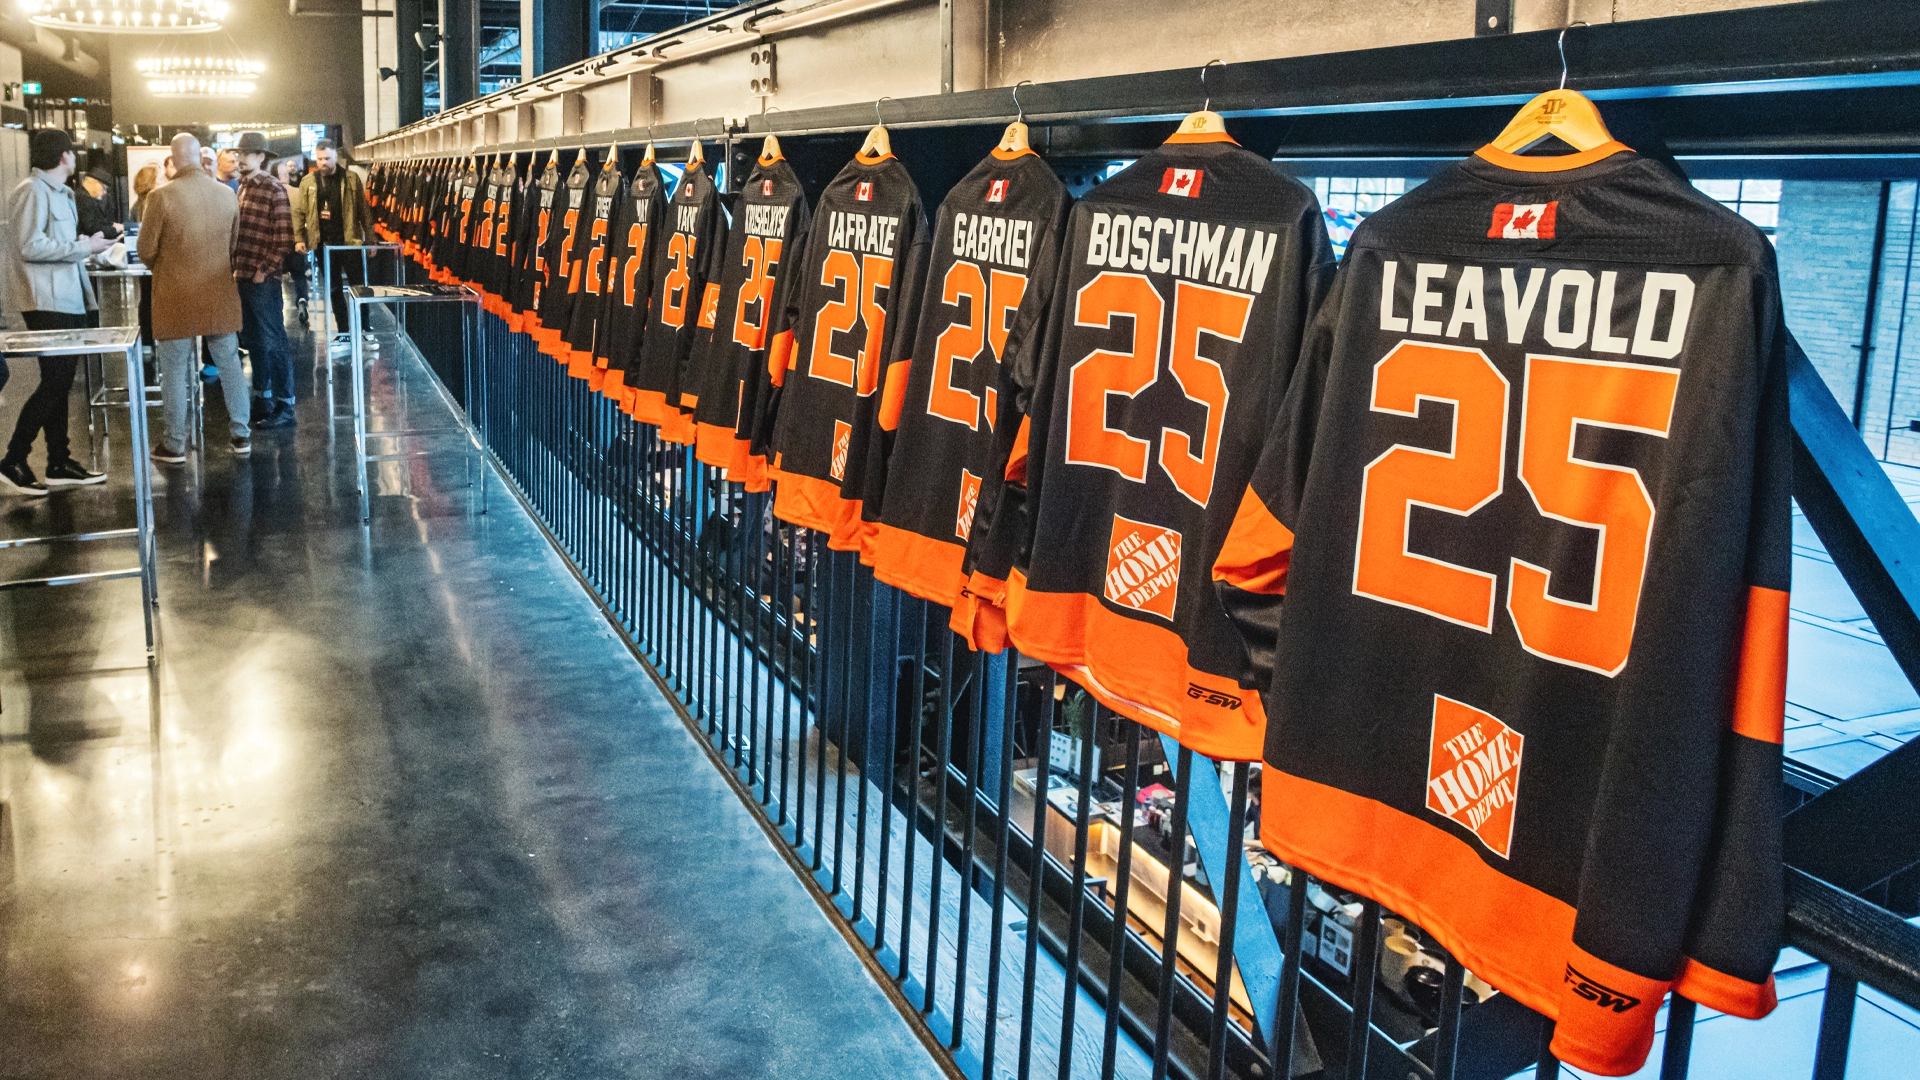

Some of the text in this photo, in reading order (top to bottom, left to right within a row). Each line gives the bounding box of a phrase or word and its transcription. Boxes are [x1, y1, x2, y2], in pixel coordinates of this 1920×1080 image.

[828, 210, 900, 257] IAFRATE
[1086, 212, 1278, 295] BOSCHMAN
[732, 234, 783, 352] 25
[808, 249, 895, 398] 25
[1380, 260, 1696, 360] LEAVOLD
[926, 259, 1030, 433] 25
[1063, 270, 1256, 510] 25
[1113, 530, 1146, 562] THE
[1351, 338, 1682, 679] 25
[1105, 529, 1181, 601] HOME
[1127, 564, 1179, 608] DEPOT
[1429, 727, 1522, 816] HOME
[1442, 722, 1488, 762] THE
[1466, 777, 1515, 832] DEPOT
